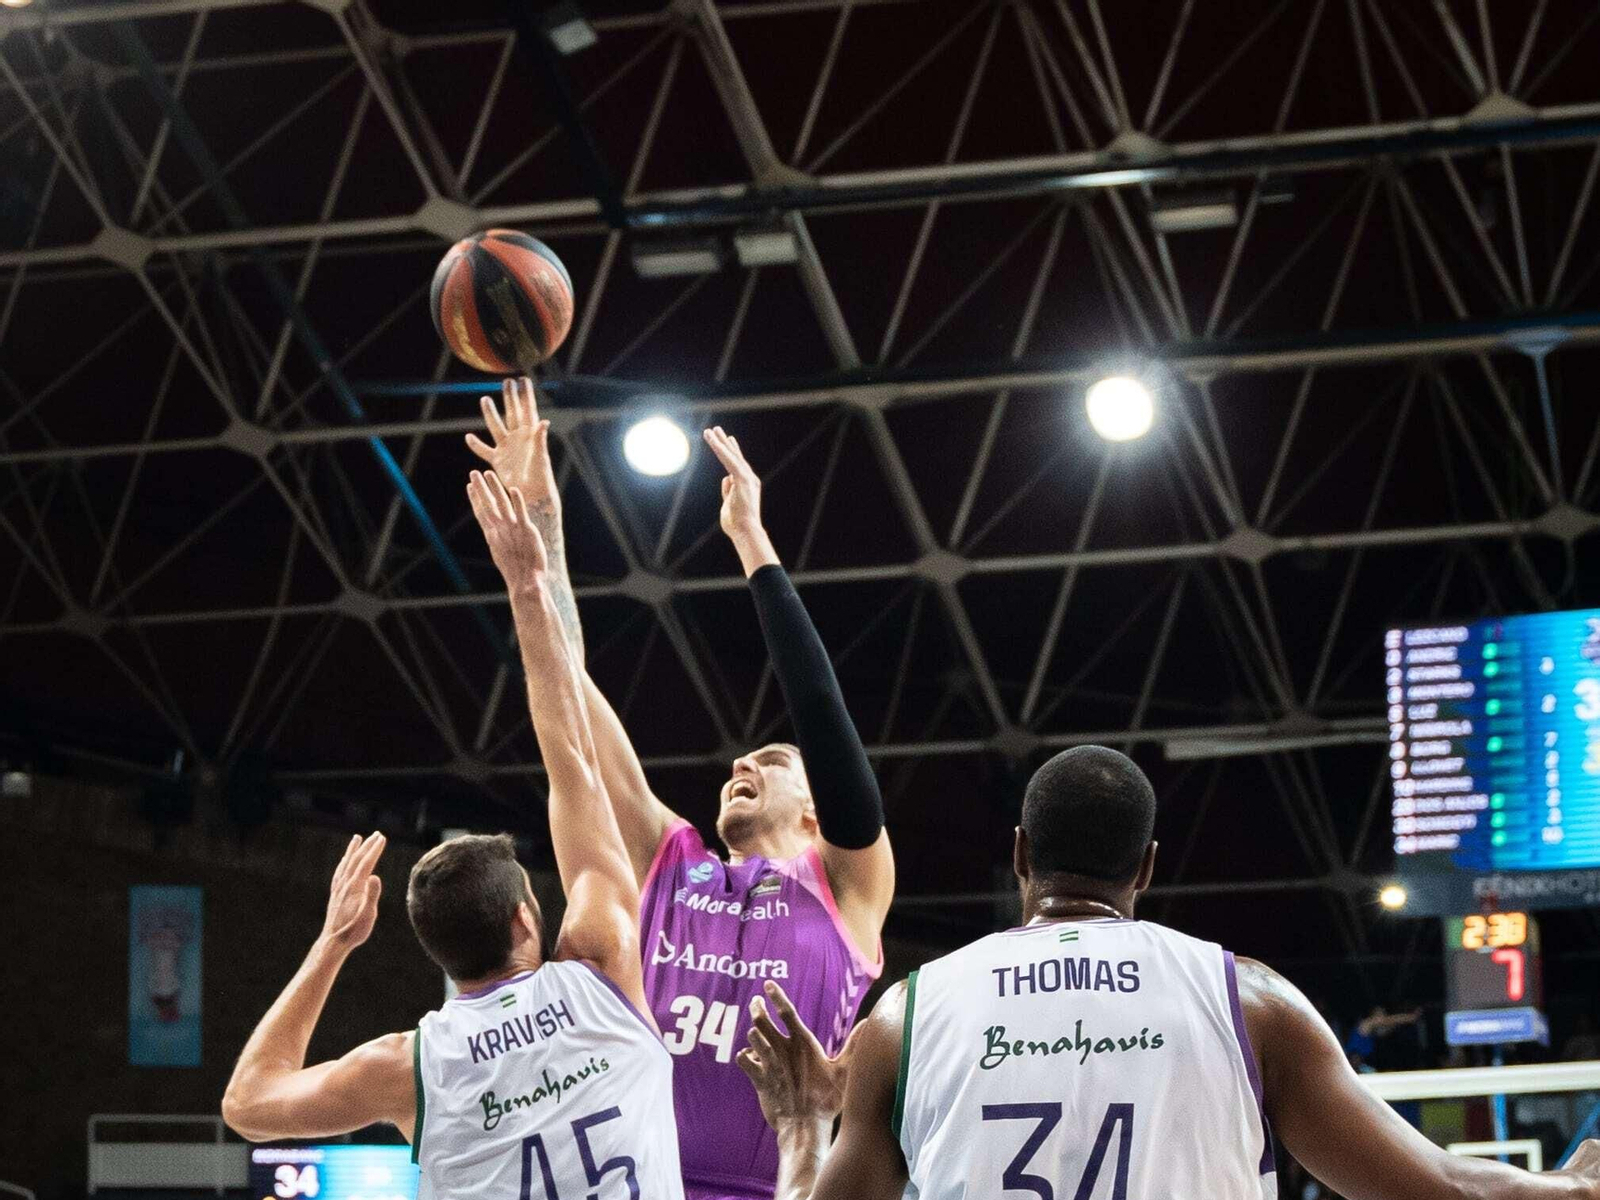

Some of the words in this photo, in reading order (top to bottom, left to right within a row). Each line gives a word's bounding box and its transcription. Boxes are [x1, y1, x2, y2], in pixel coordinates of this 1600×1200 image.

[674, 943, 790, 979] Andorra
[992, 957, 1140, 997] THOMAS
[1491, 948, 1525, 1001] 7
[467, 999, 575, 1064] KRAVISH
[663, 995, 740, 1064] 34
[274, 1164, 320, 1199] 34
